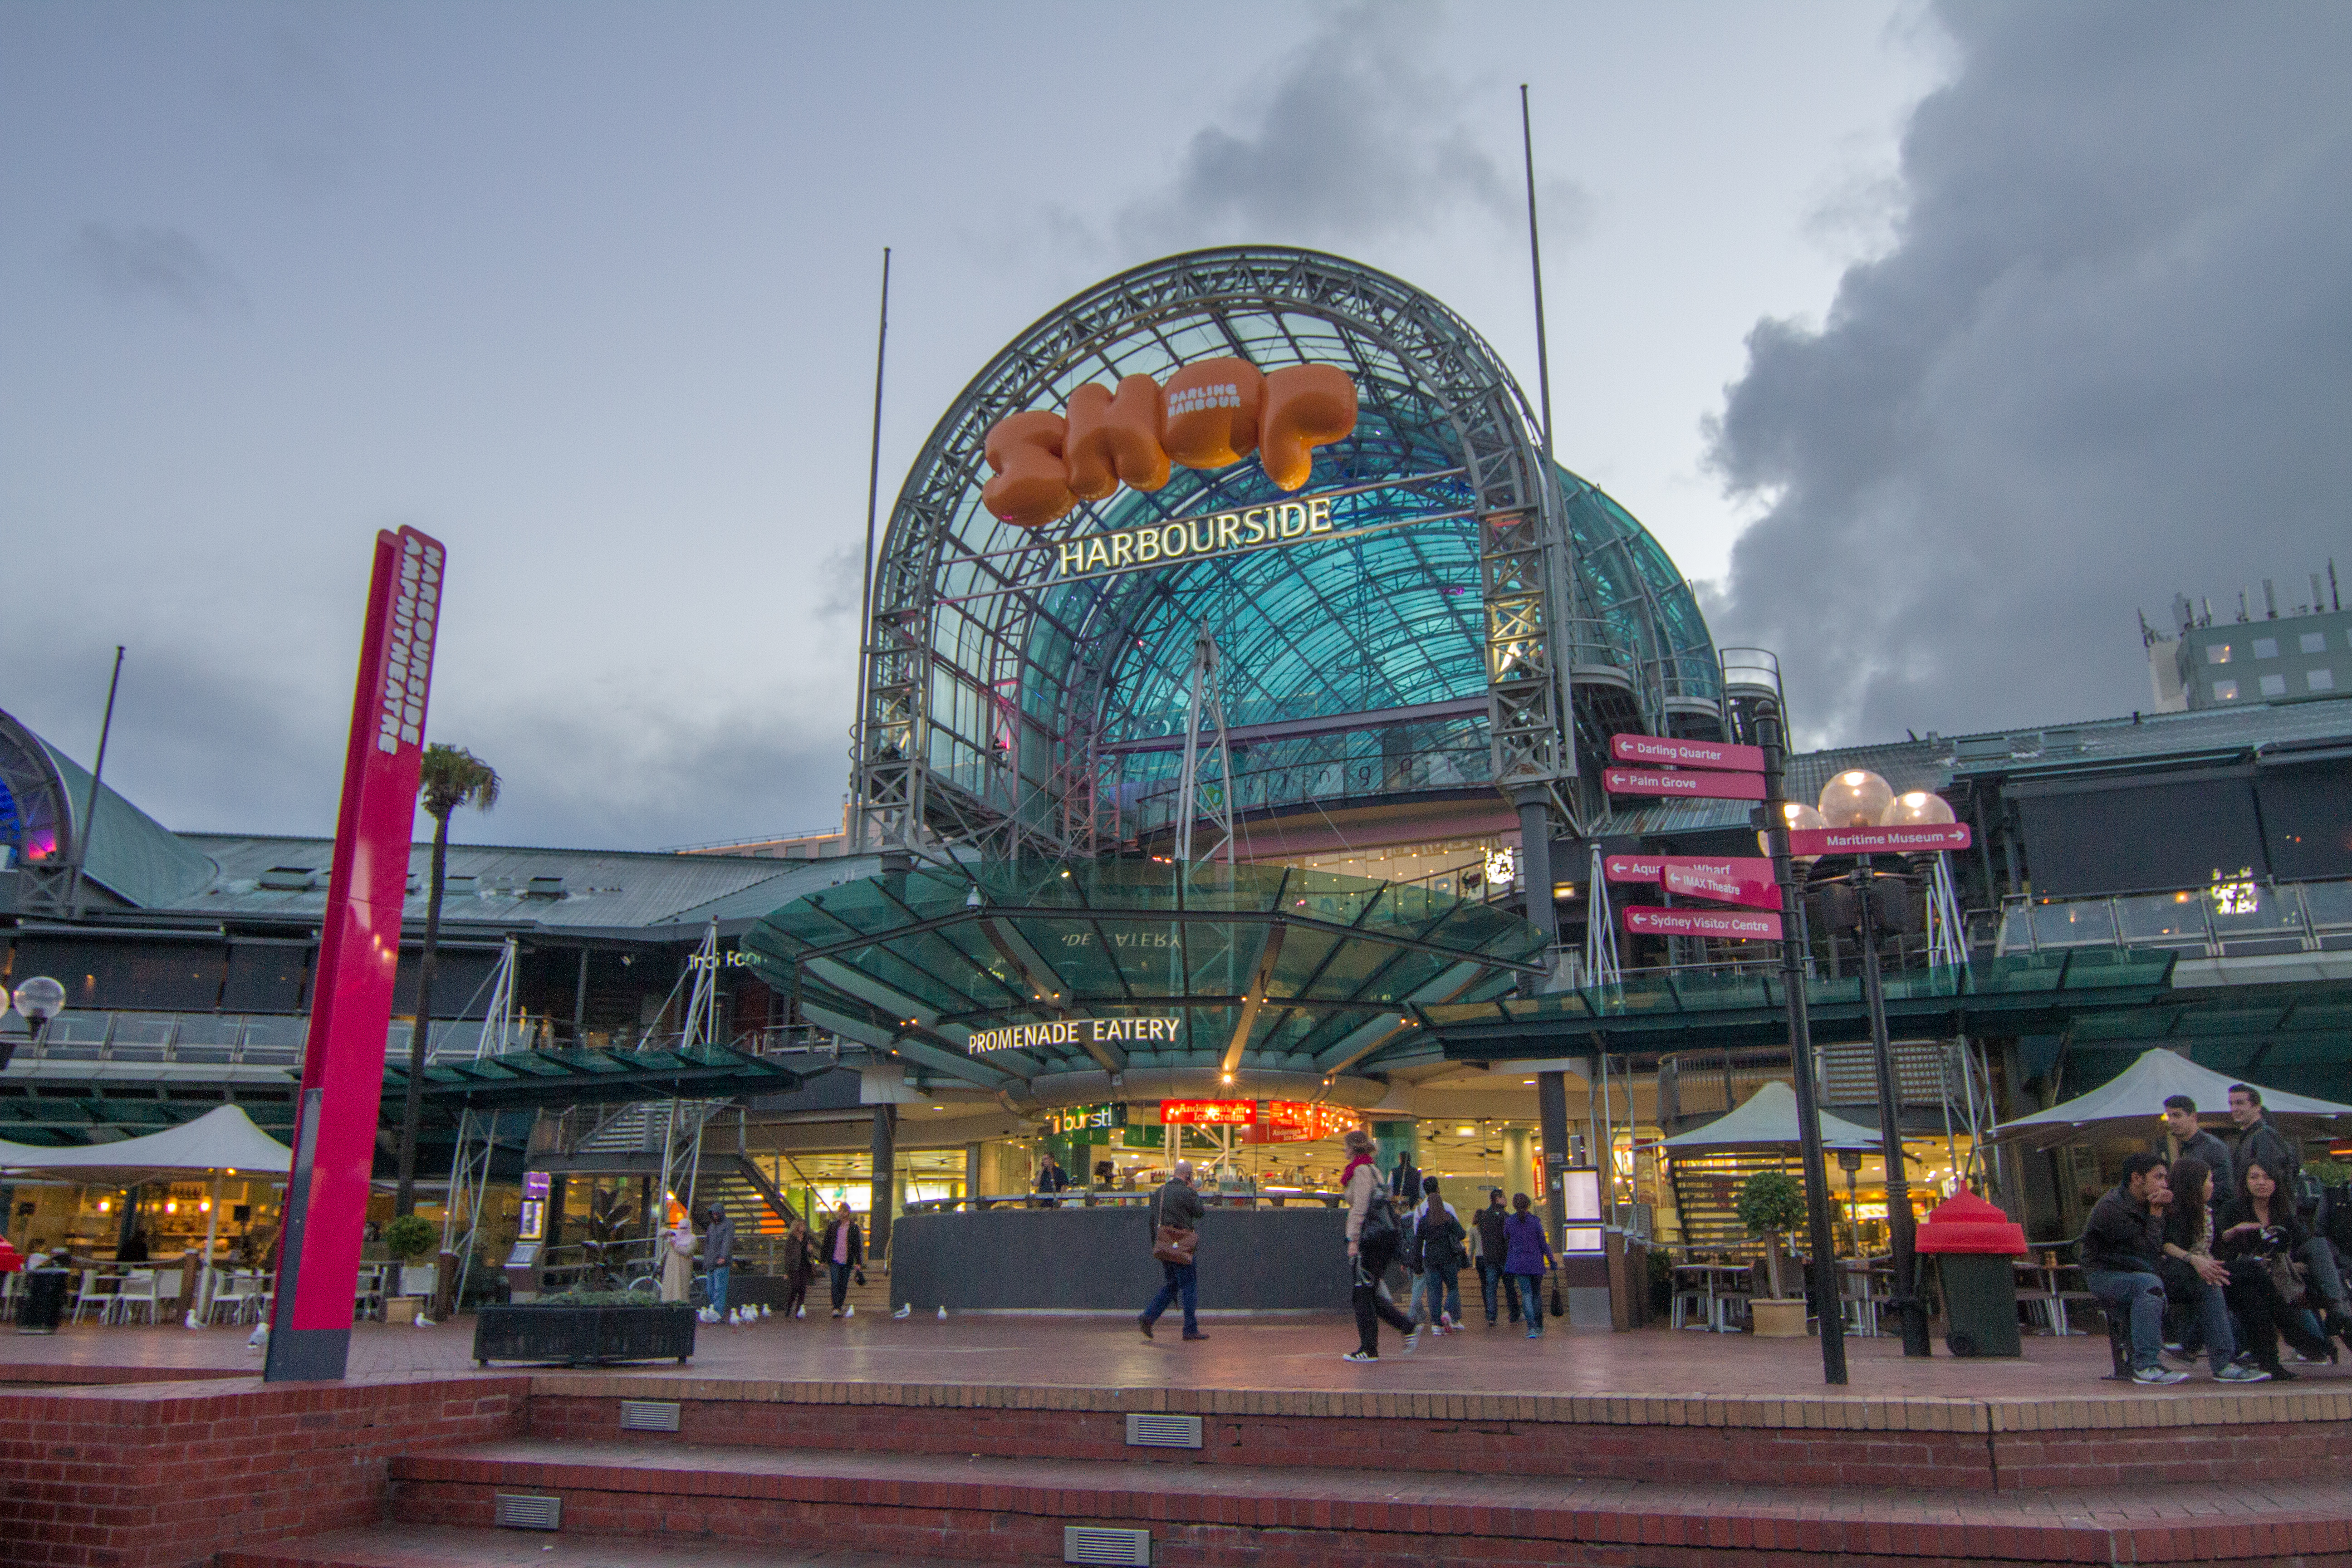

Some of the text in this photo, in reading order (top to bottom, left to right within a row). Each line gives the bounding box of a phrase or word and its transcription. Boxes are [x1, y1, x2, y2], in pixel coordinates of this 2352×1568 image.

[1170, 384, 1237, 405] DARLING
[1168, 395, 1241, 417] HARBOUR
[1059, 498, 1333, 575] HARBOURSIDE
[377, 534, 423, 755] AMPHITHEATRE
[400, 545, 443, 745] HARBOURSIDE
[1637, 743, 1721, 760] Darling Quarter
[1630, 775, 1696, 789] Palm Grove
[1827, 833, 1944, 846] Maritime Museum
[1693, 864, 1731, 875] Wharf
[1683, 875, 1741, 895] IMAX Theatre
[1651, 915, 1769, 931] Sydney Visitor Centre
[968, 1019, 1181, 1055] PROMENADE EATERY
[1194, 1112, 1245, 1122] Ice Cream
